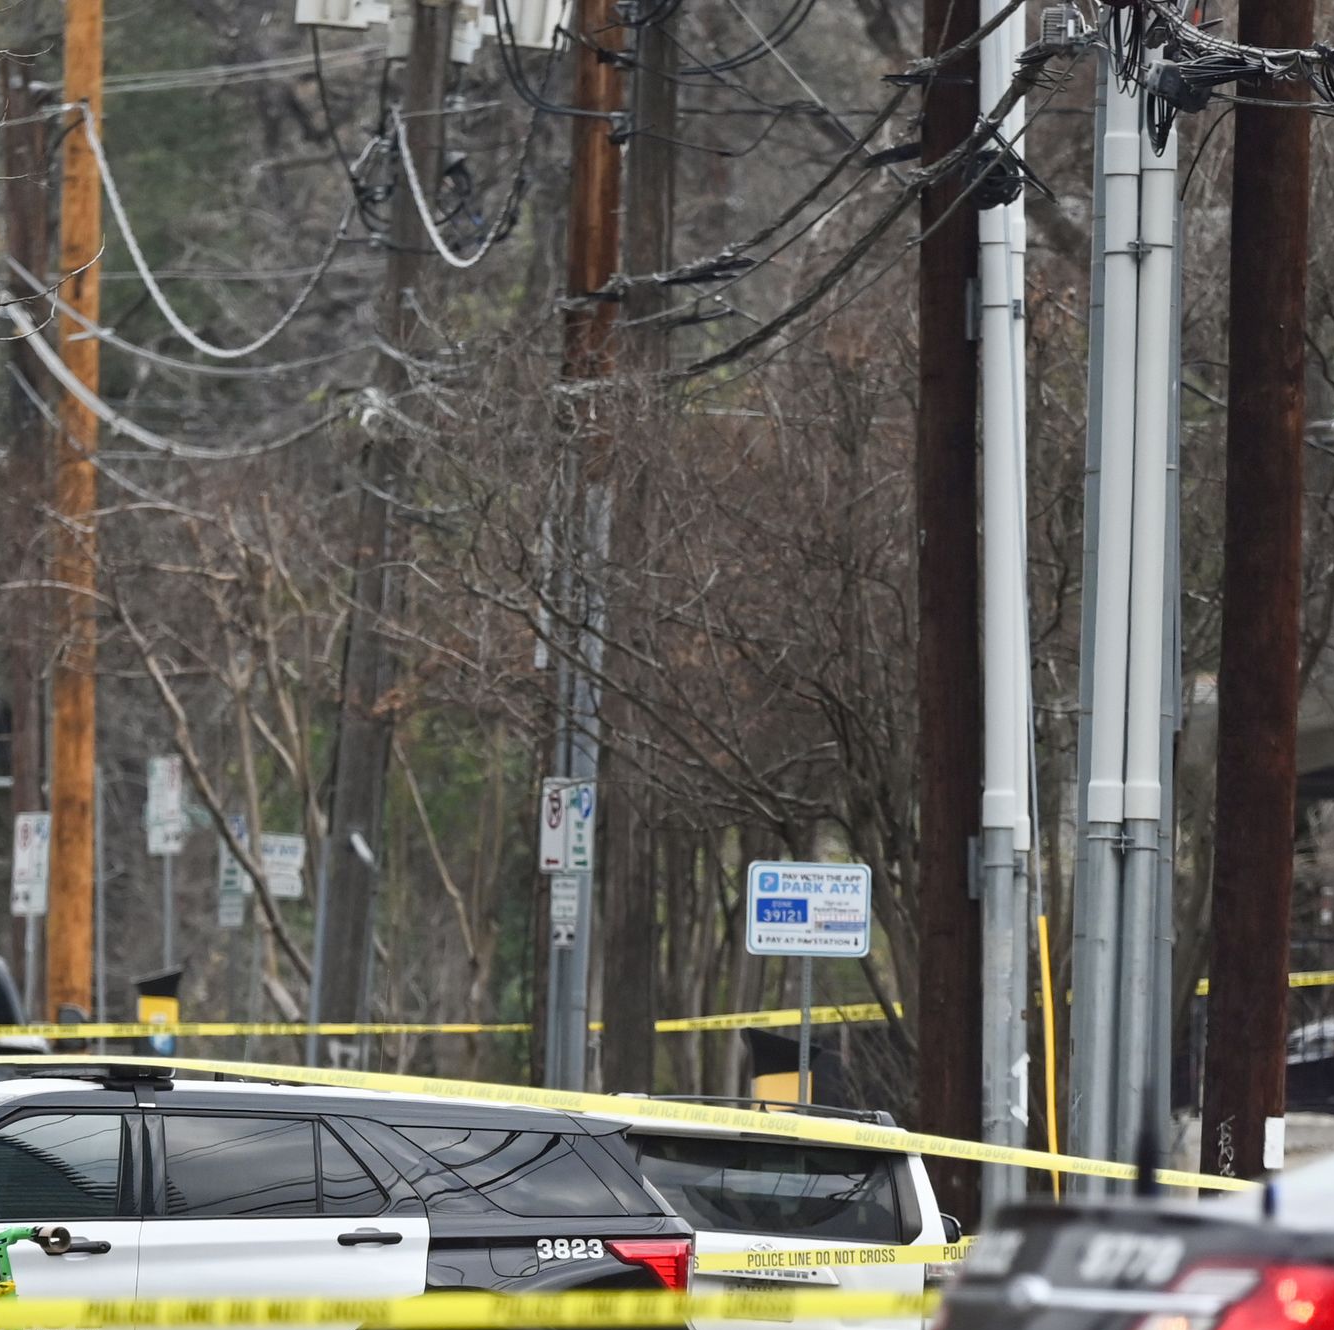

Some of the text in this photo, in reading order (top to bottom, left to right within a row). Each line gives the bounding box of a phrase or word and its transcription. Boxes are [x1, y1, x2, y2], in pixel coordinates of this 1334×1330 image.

[781, 881, 861, 894] PARK ATX
[763, 908, 803, 922] 39121
[537, 1238, 605, 1259] 3823
[747, 1248, 896, 1268] POLICE LINE DO NOT CROSS
